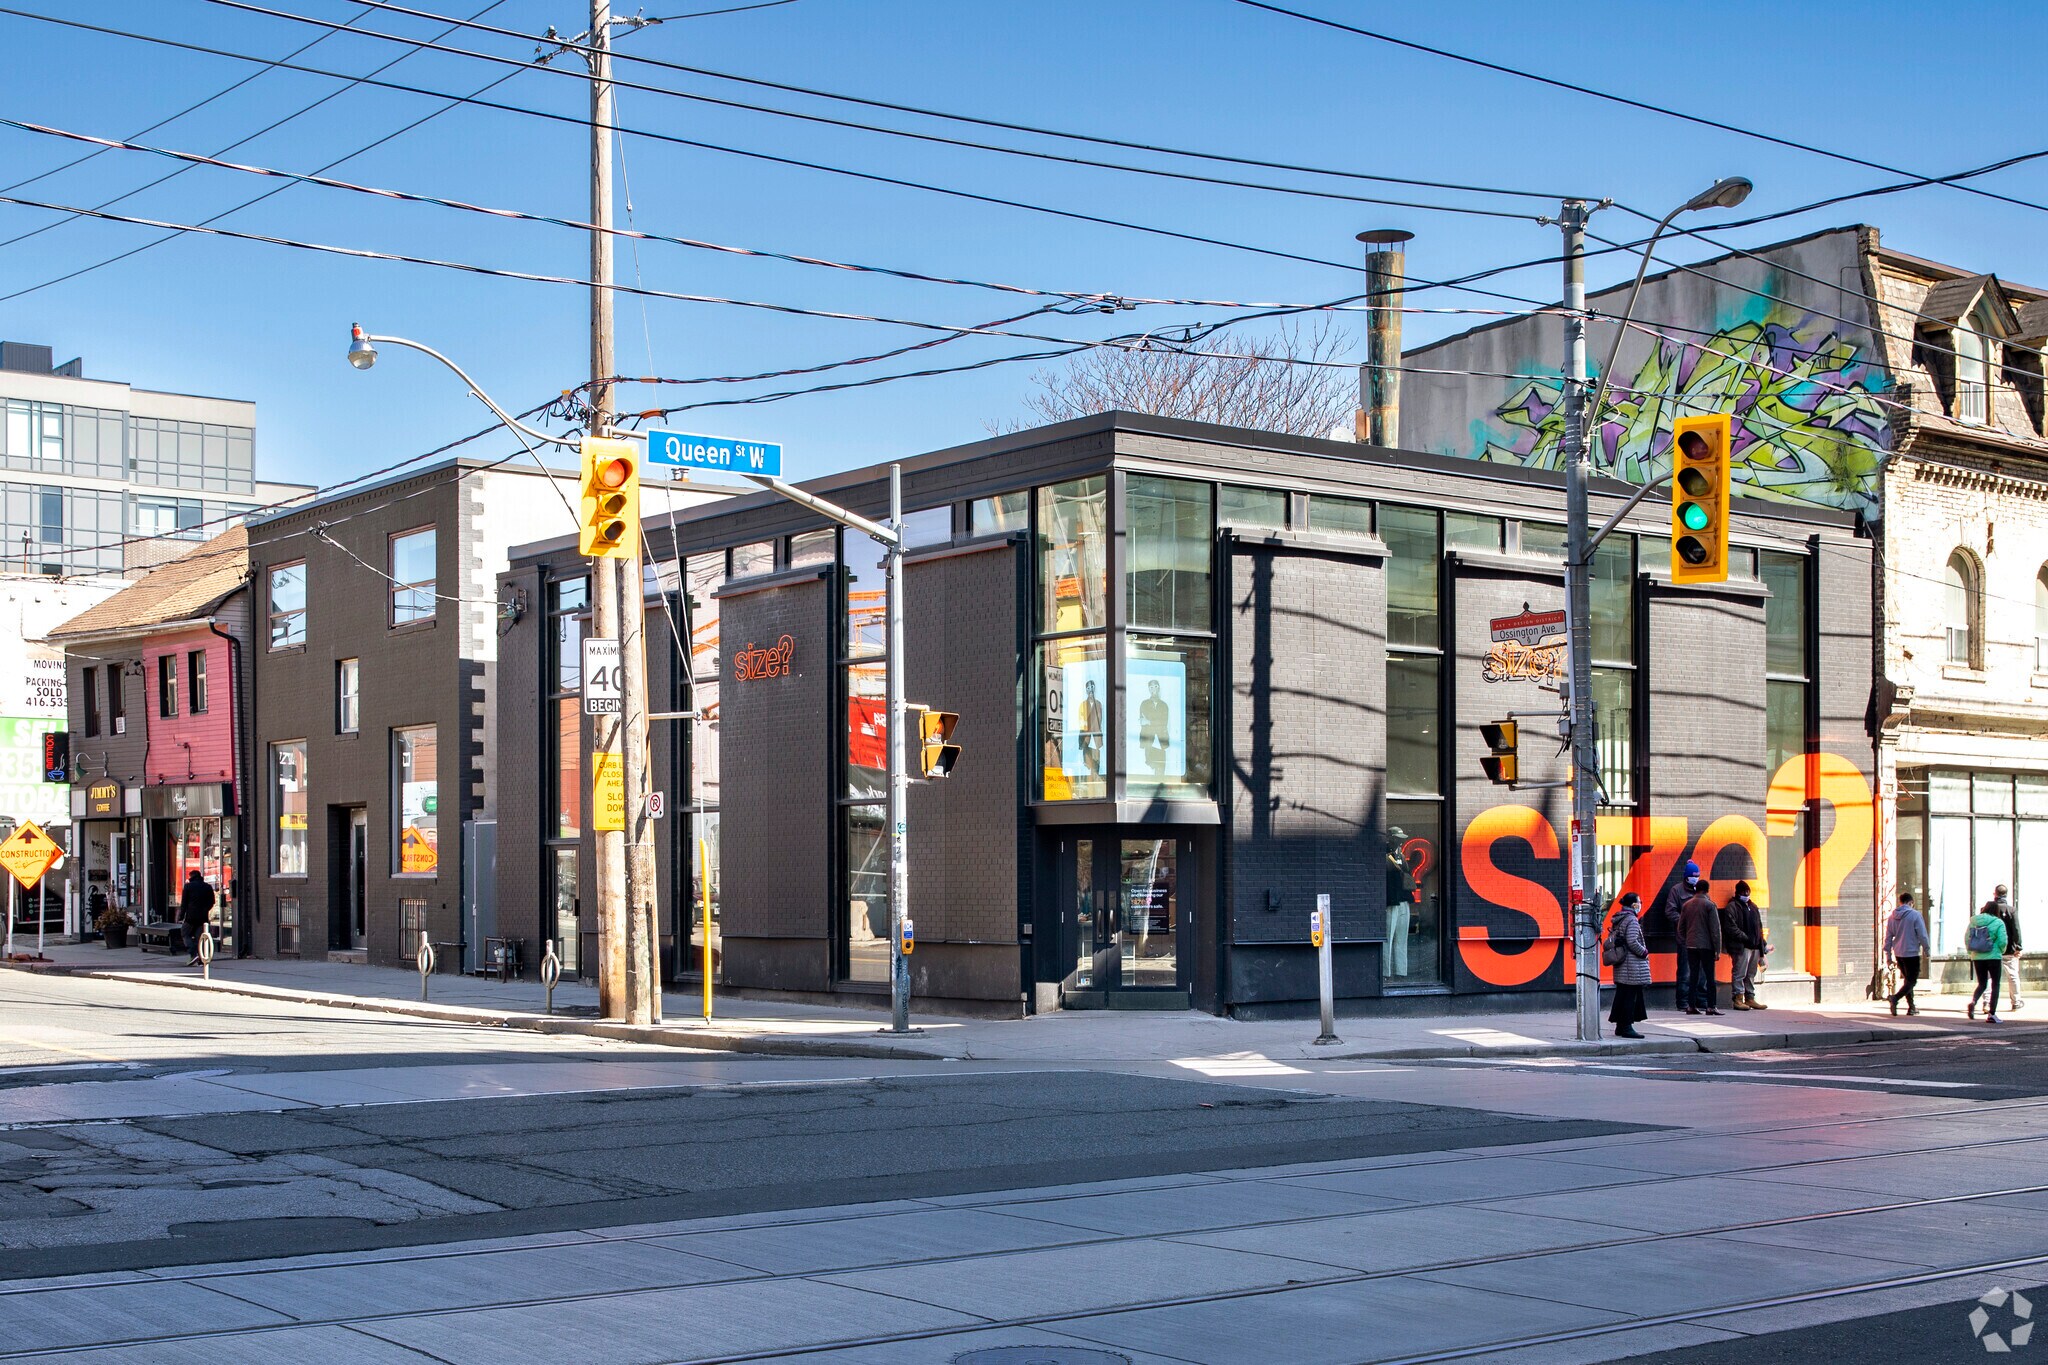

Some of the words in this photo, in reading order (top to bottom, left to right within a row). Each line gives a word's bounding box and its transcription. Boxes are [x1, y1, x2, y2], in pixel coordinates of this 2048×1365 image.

[665, 436, 731, 465] Queen
[735, 444, 746, 457] St
[749, 446, 765, 469] W
[1513, 620, 1534, 628] DESIGN
[1536, 616, 1561, 625] DISTRICT
[1499, 628, 1539, 640] Ossington
[1541, 625, 1558, 634] Ave.
[735, 634, 794, 681] size?
[26, 677, 61, 687] PACKING
[36, 687, 62, 697] SOLD
[46, 734, 54, 770] COFFEE
[599, 761, 617, 769] CURB
[90, 784, 116, 800] JIMMY'S
[0, 849, 56, 858] CONSTRUCTION
